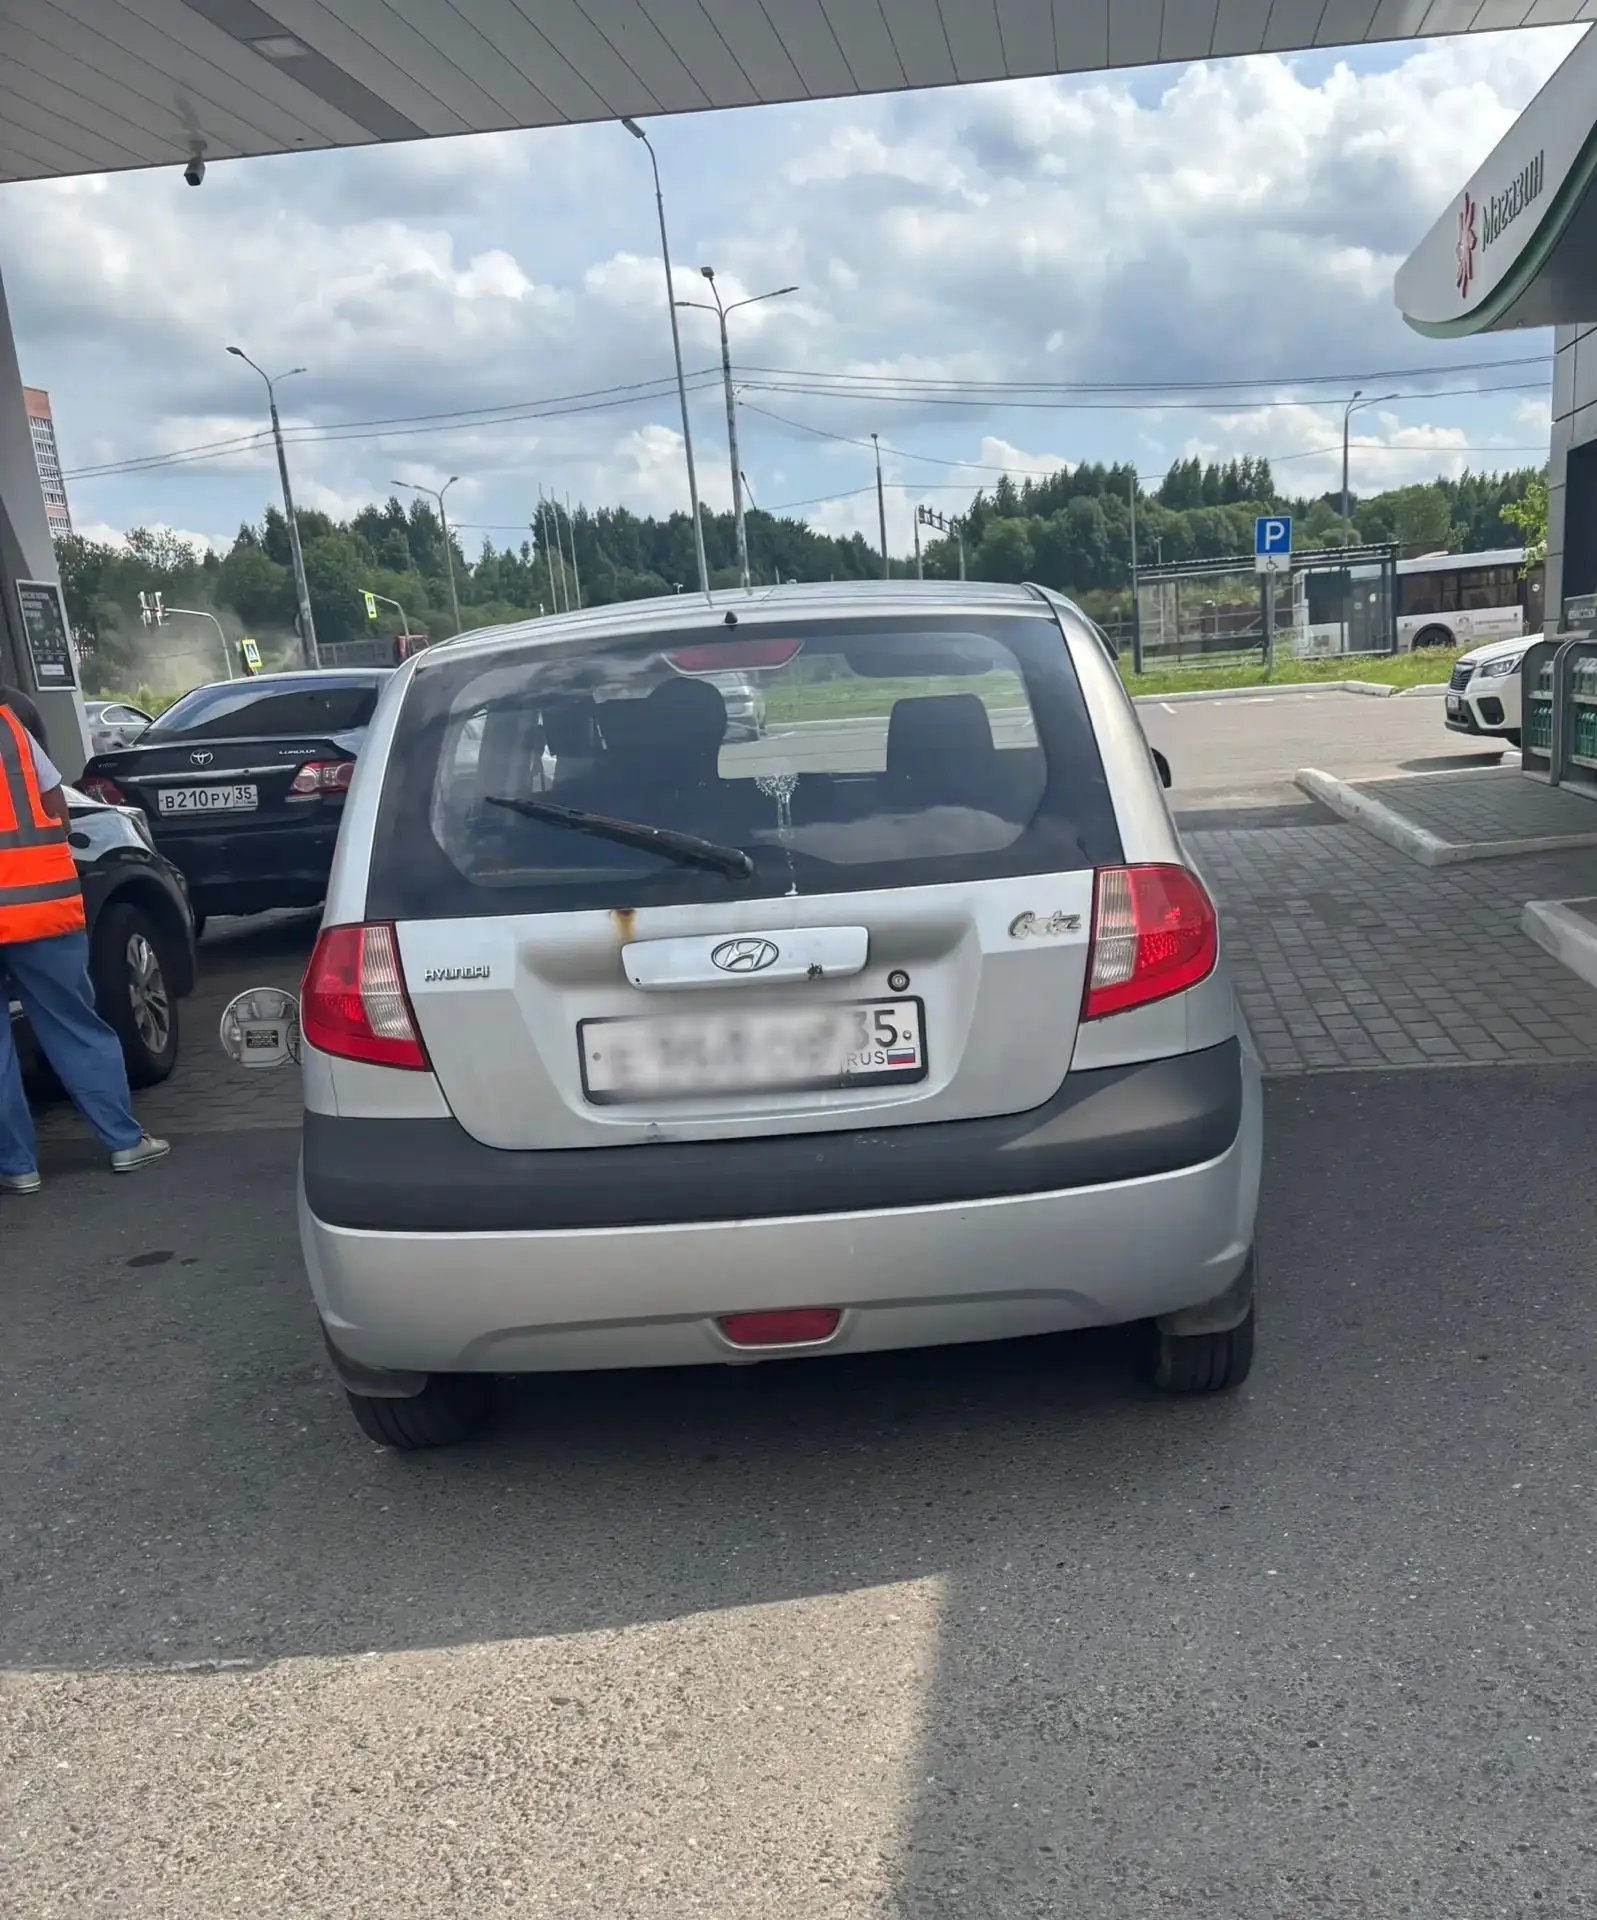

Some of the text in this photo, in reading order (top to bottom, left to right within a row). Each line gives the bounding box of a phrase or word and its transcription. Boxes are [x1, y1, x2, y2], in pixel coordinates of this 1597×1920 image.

[1265, 521, 1285, 550] P
[235, 787, 252, 800] 35
[424, 964, 491, 982] HYUNDAI
[847, 1050, 886, 1067] RUS
